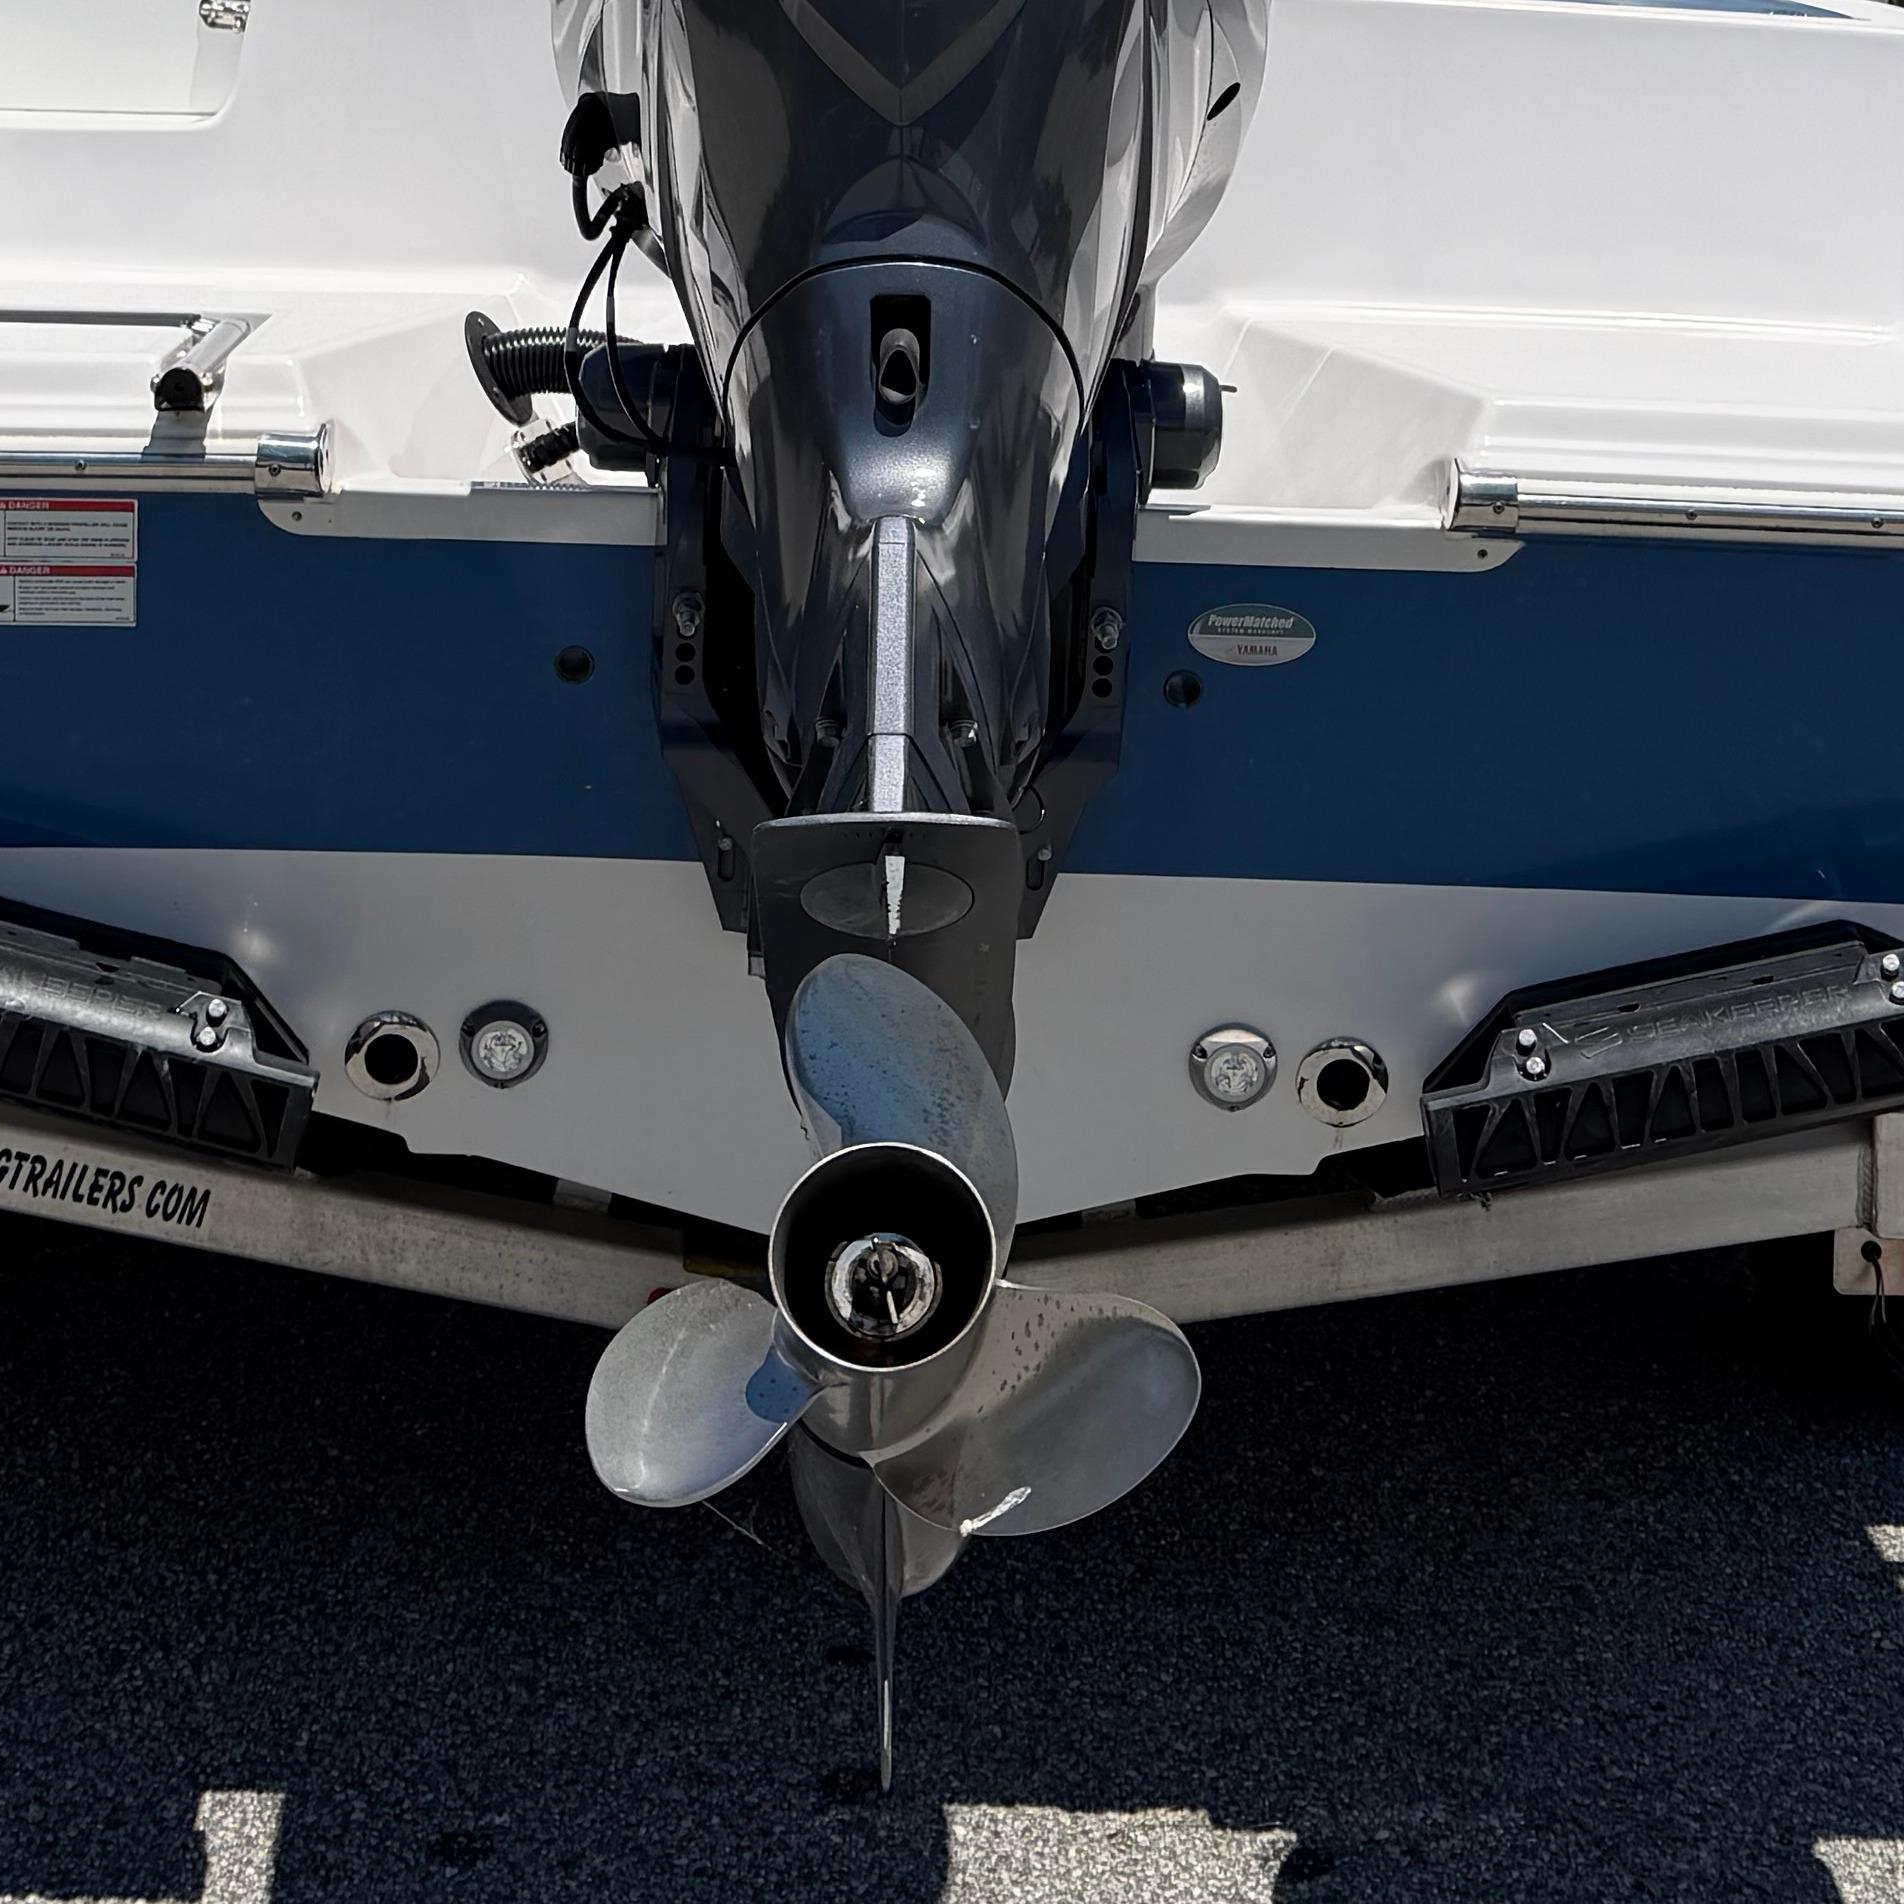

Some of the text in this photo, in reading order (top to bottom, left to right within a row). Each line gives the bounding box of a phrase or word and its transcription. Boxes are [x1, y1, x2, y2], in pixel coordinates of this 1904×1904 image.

[8, 501, 49, 510] DANGER
[8, 567, 50, 575] DANGER
[1236, 644, 1278, 656] YAMAHA
